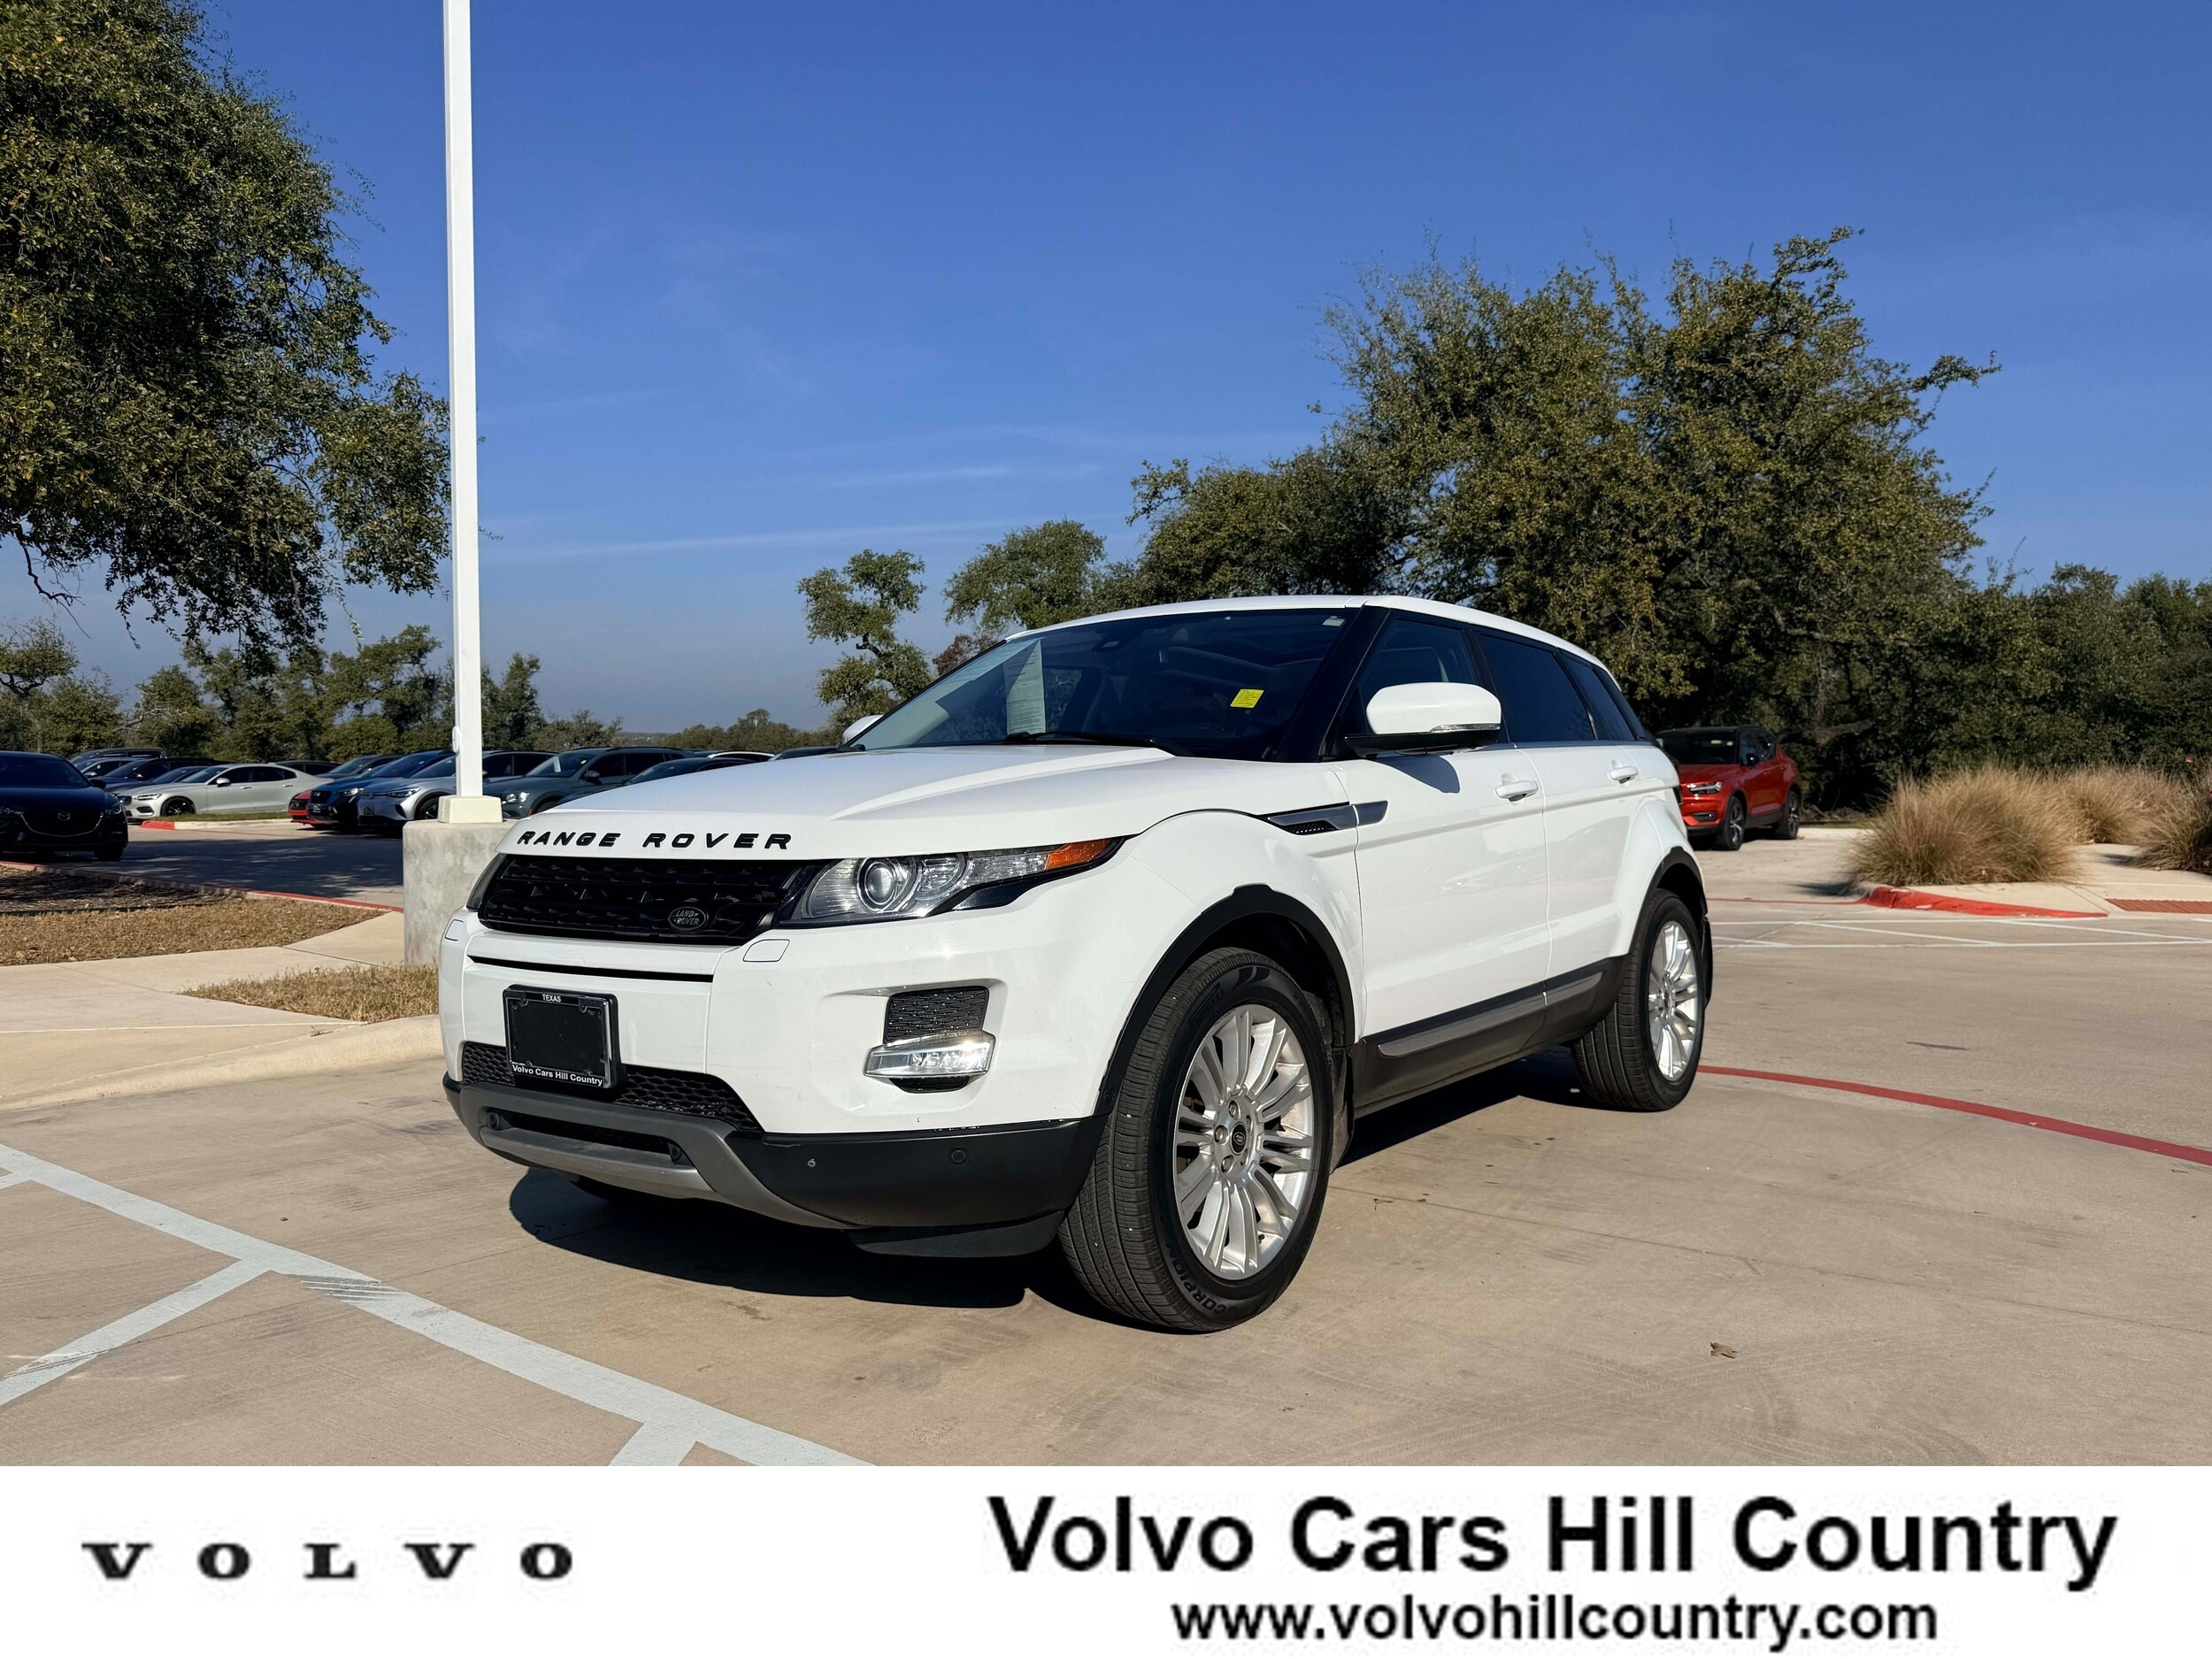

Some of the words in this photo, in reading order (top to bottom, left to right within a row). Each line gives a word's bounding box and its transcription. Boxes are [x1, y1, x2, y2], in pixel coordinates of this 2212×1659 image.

[517, 830, 621, 848] RANGE
[641, 832, 793, 850] ROVER
[676, 917, 700, 926] ROVER
[541, 994, 562, 1003] TEXAS
[511, 1064, 534, 1075] Volvo
[535, 1068, 554, 1079] Cars
[555, 1071, 569, 1080] Hill
[570, 1073, 603, 1087] Country
